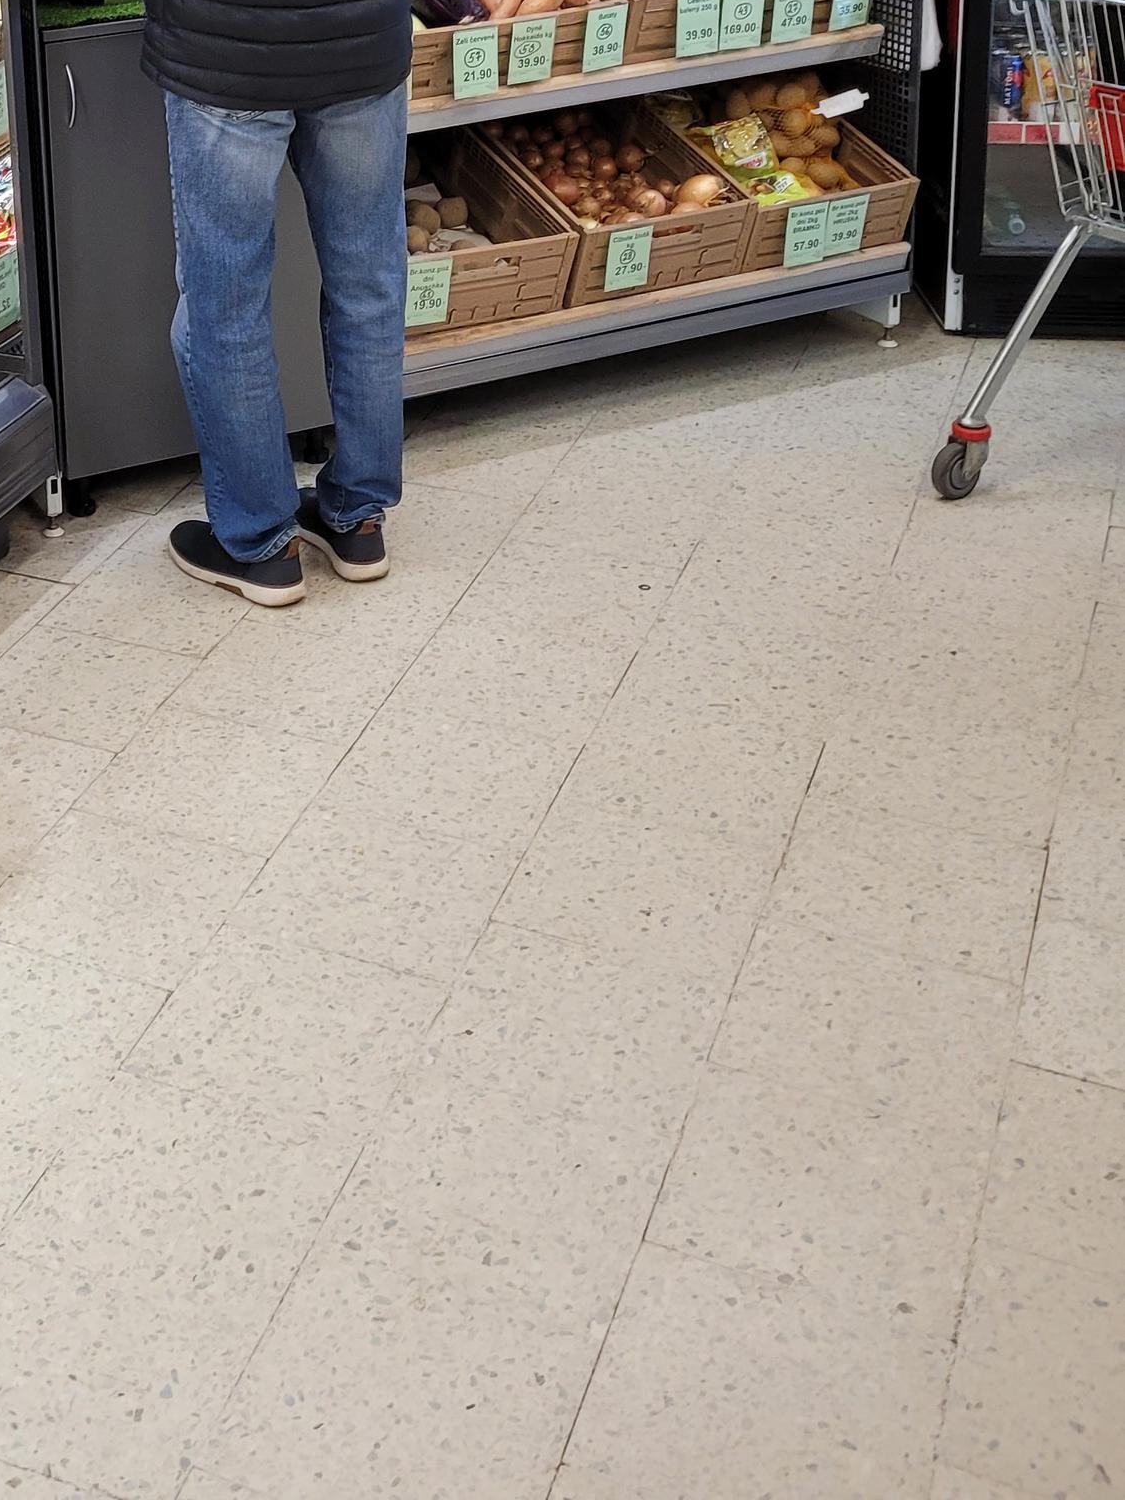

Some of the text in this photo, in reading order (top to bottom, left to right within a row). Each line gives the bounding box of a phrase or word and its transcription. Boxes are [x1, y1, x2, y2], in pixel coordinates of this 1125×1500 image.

[737, 5, 749, 16] 43
[838, 2, 864, 16] 35.90
[724, 21, 757, 35] 169.00
[781, 15, 807, 28] 47.90
[526, 23, 542, 34] Dyně
[685, 27, 713, 41] 39.90
[455, 32, 495, 46] Zelí červené
[592, 43, 619, 55] 38.90
[467, 50, 482, 63] 57
[517, 56, 546, 69] 39.90
[463, 68, 492, 82] 21.90
[1004, 64, 1013, 107] MATTONI
[831, 229, 857, 242] 39.90
[793, 238, 819, 251] 57.90
[614, 262, 643, 276] 27.90
[412, 297, 443, 311] 19.90
